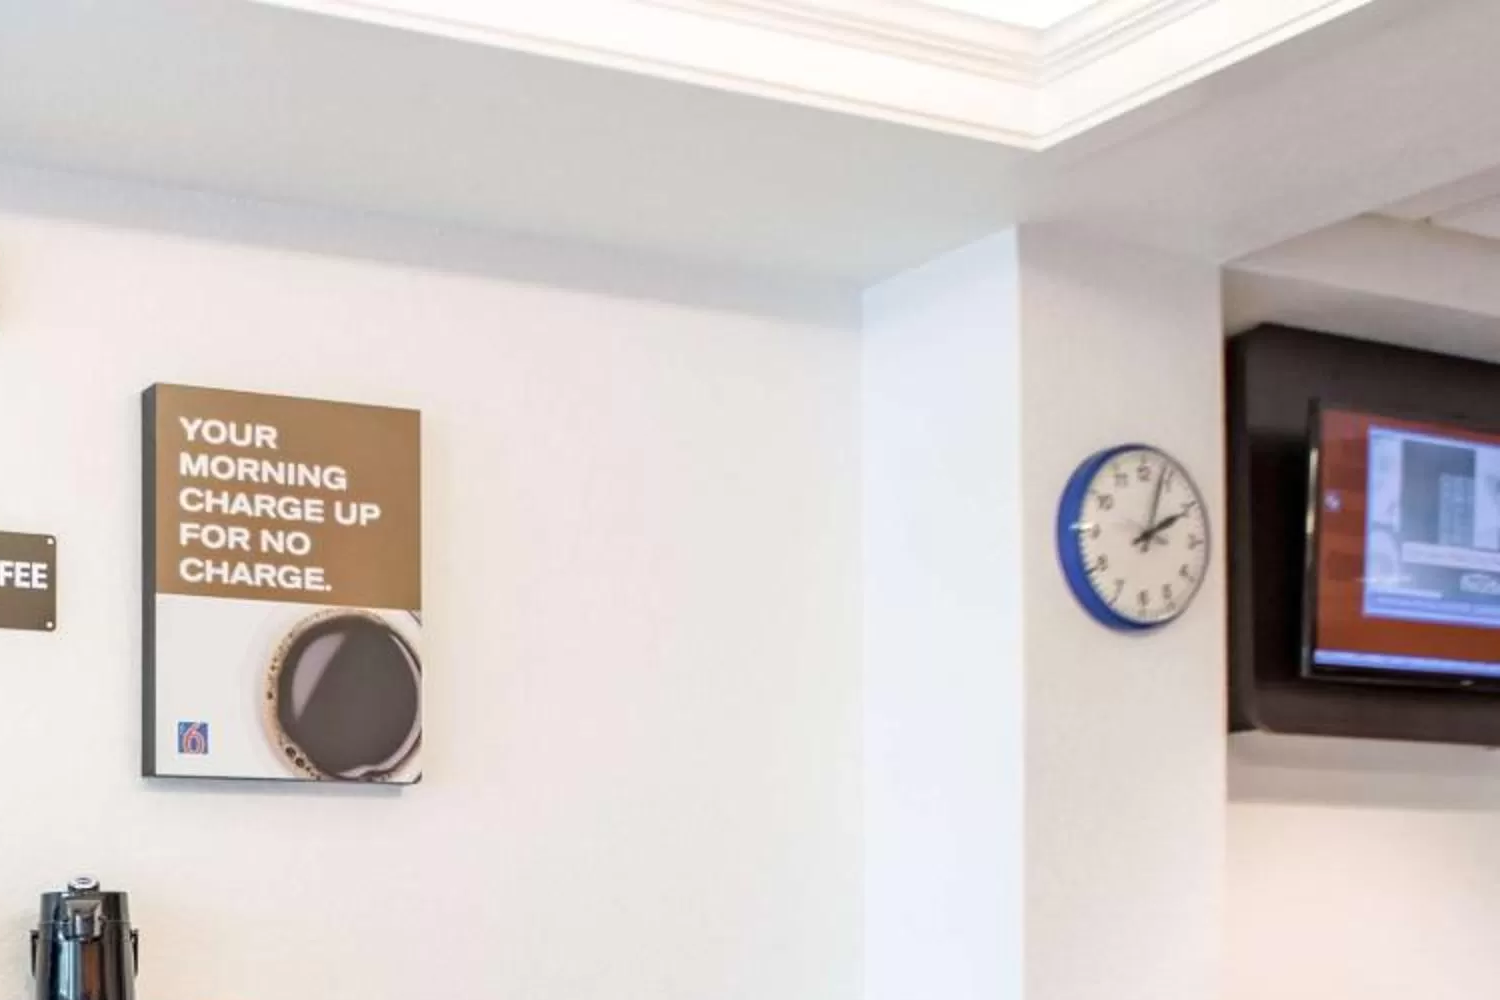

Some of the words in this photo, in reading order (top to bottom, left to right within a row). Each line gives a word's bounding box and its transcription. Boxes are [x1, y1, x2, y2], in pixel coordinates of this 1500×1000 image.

[179, 416, 277, 450] YOUR
[179, 452, 347, 491] MORNING
[179, 487, 324, 523] CHARGE
[334, 502, 381, 527] UP
[179, 522, 250, 552] FOR
[260, 529, 312, 556] NO
[179, 557, 333, 592] CHARGE.
